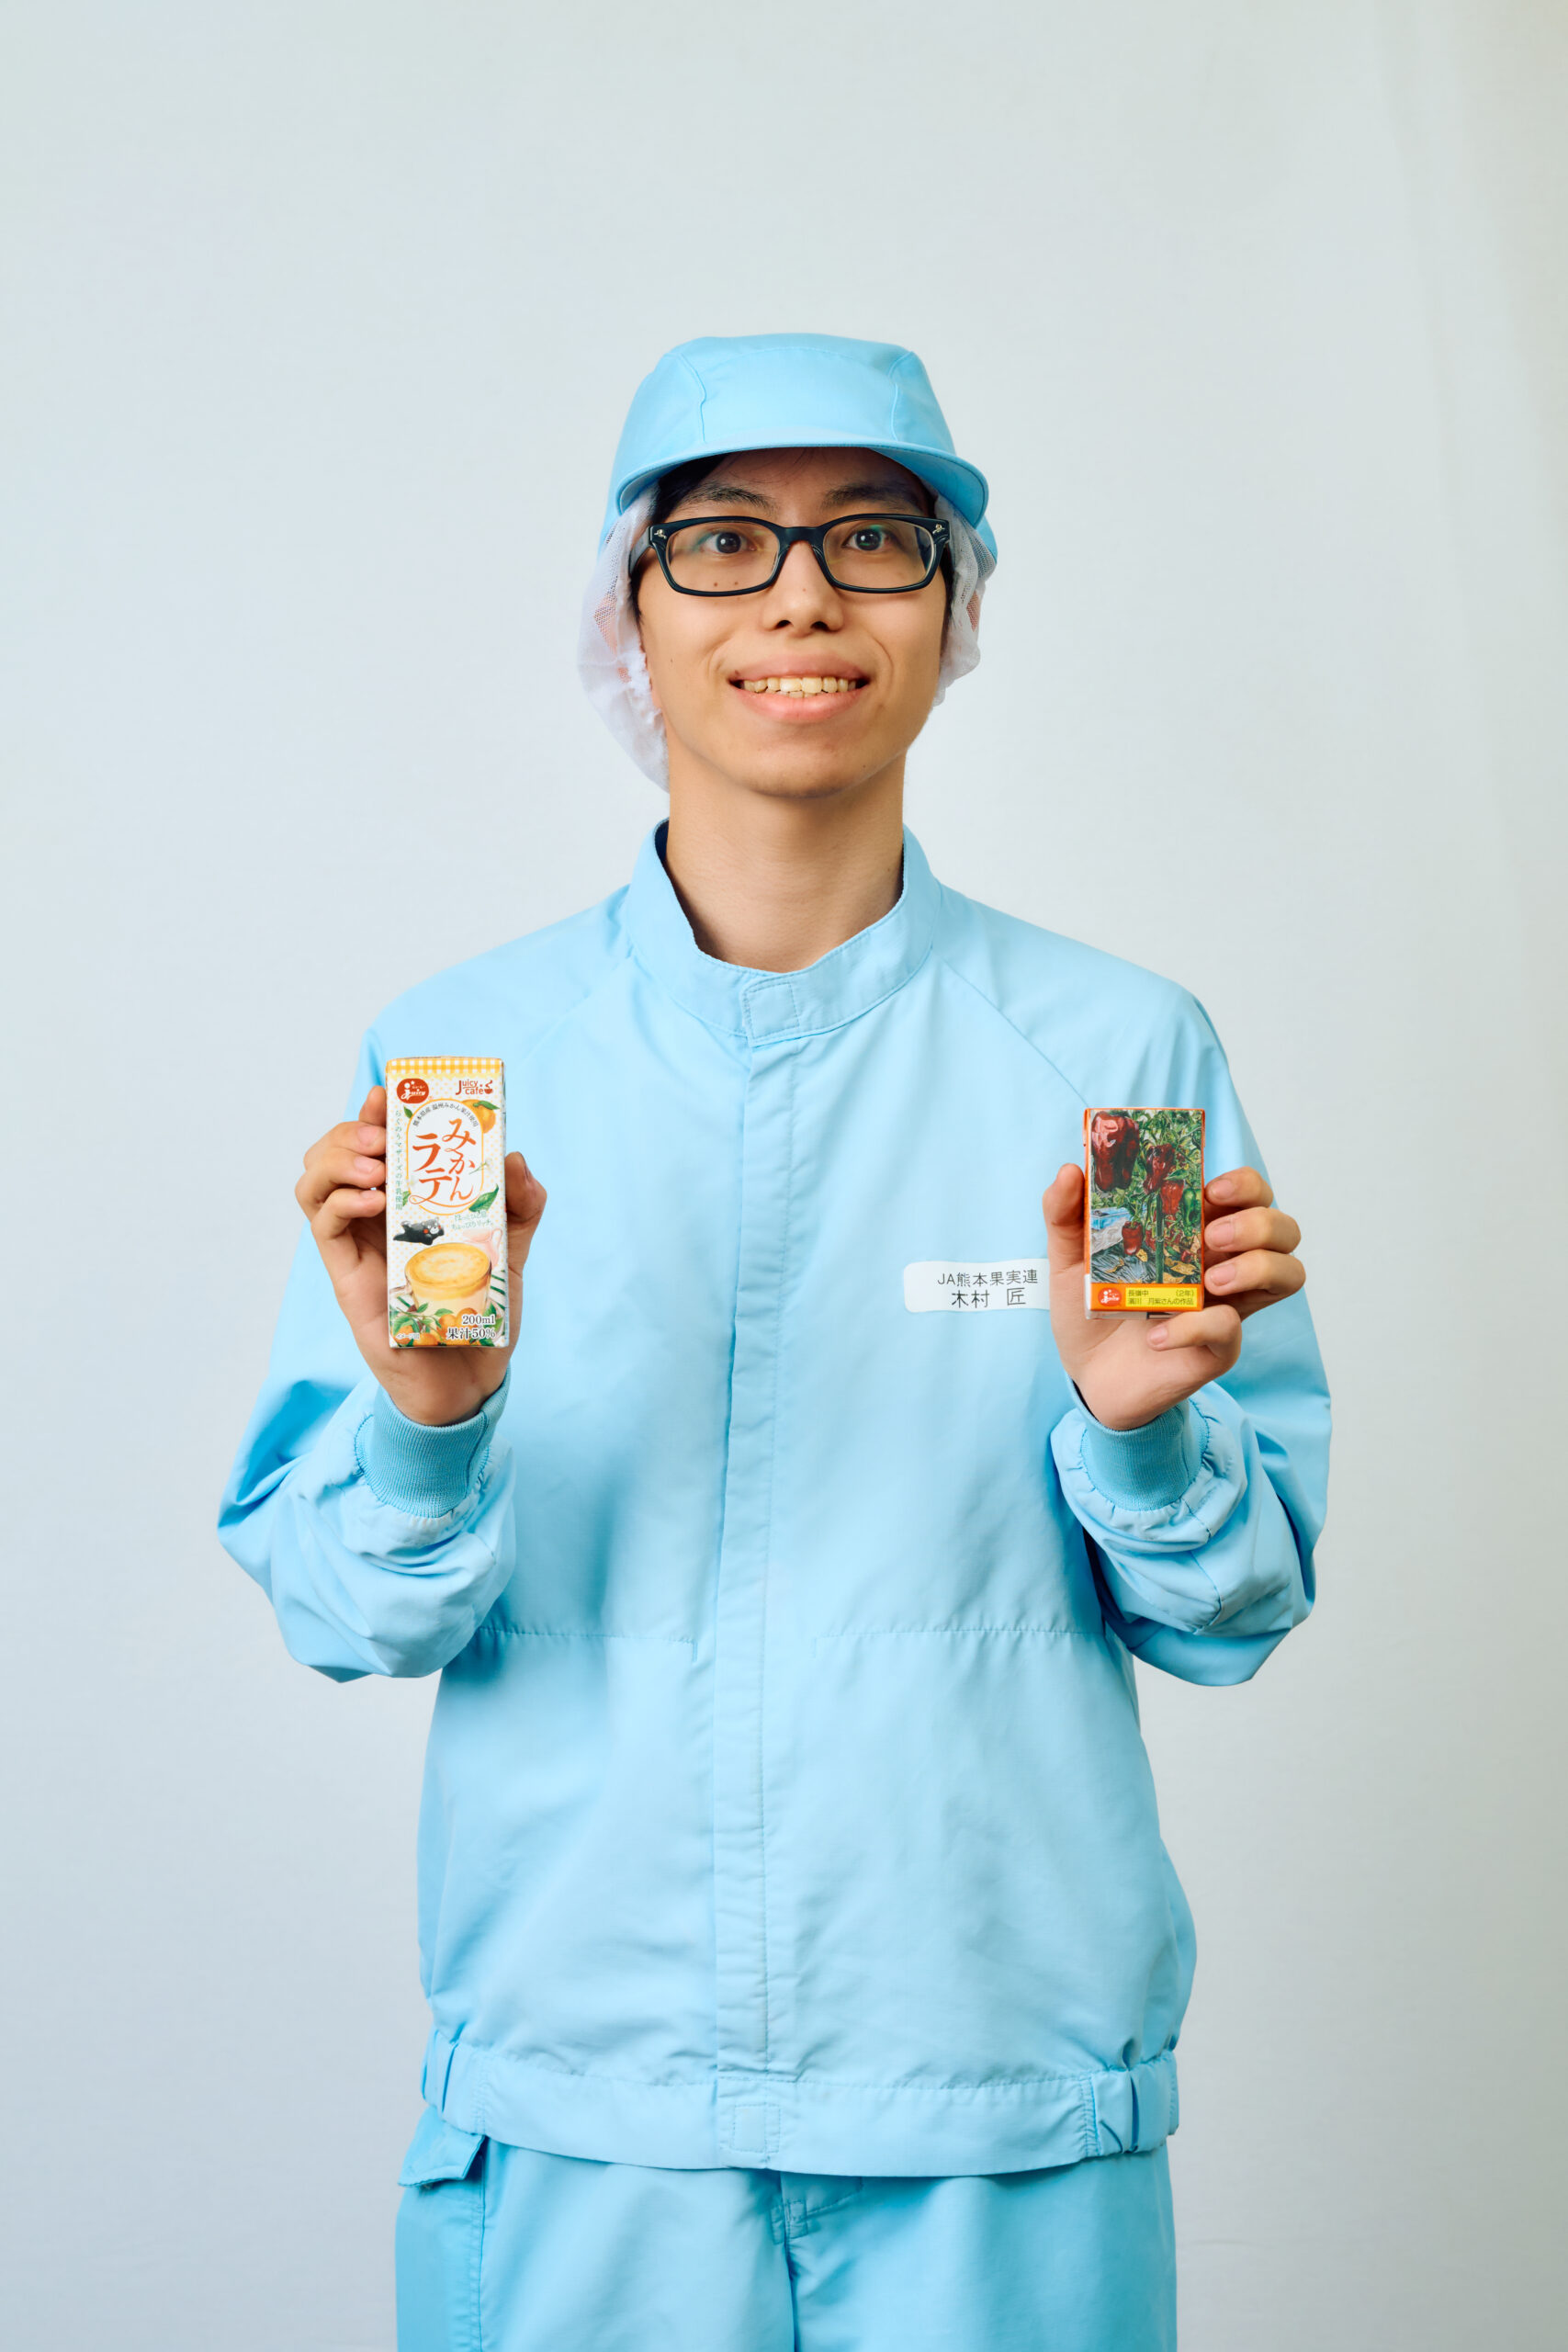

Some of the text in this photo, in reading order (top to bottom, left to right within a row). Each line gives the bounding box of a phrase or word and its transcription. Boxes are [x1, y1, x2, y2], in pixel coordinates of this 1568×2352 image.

[456, 1080, 479, 1095] Juicy
[411, 1133, 453, 1203] ラテ
[442, 1118, 477, 1202] みかん
[937, 1269, 1038, 1288] JA熊本果実連
[952, 1287, 1026, 1308] 木村 匠
[462, 1315, 496, 1325] 200ml
[447, 1328, 496, 1340] 果汁50%
